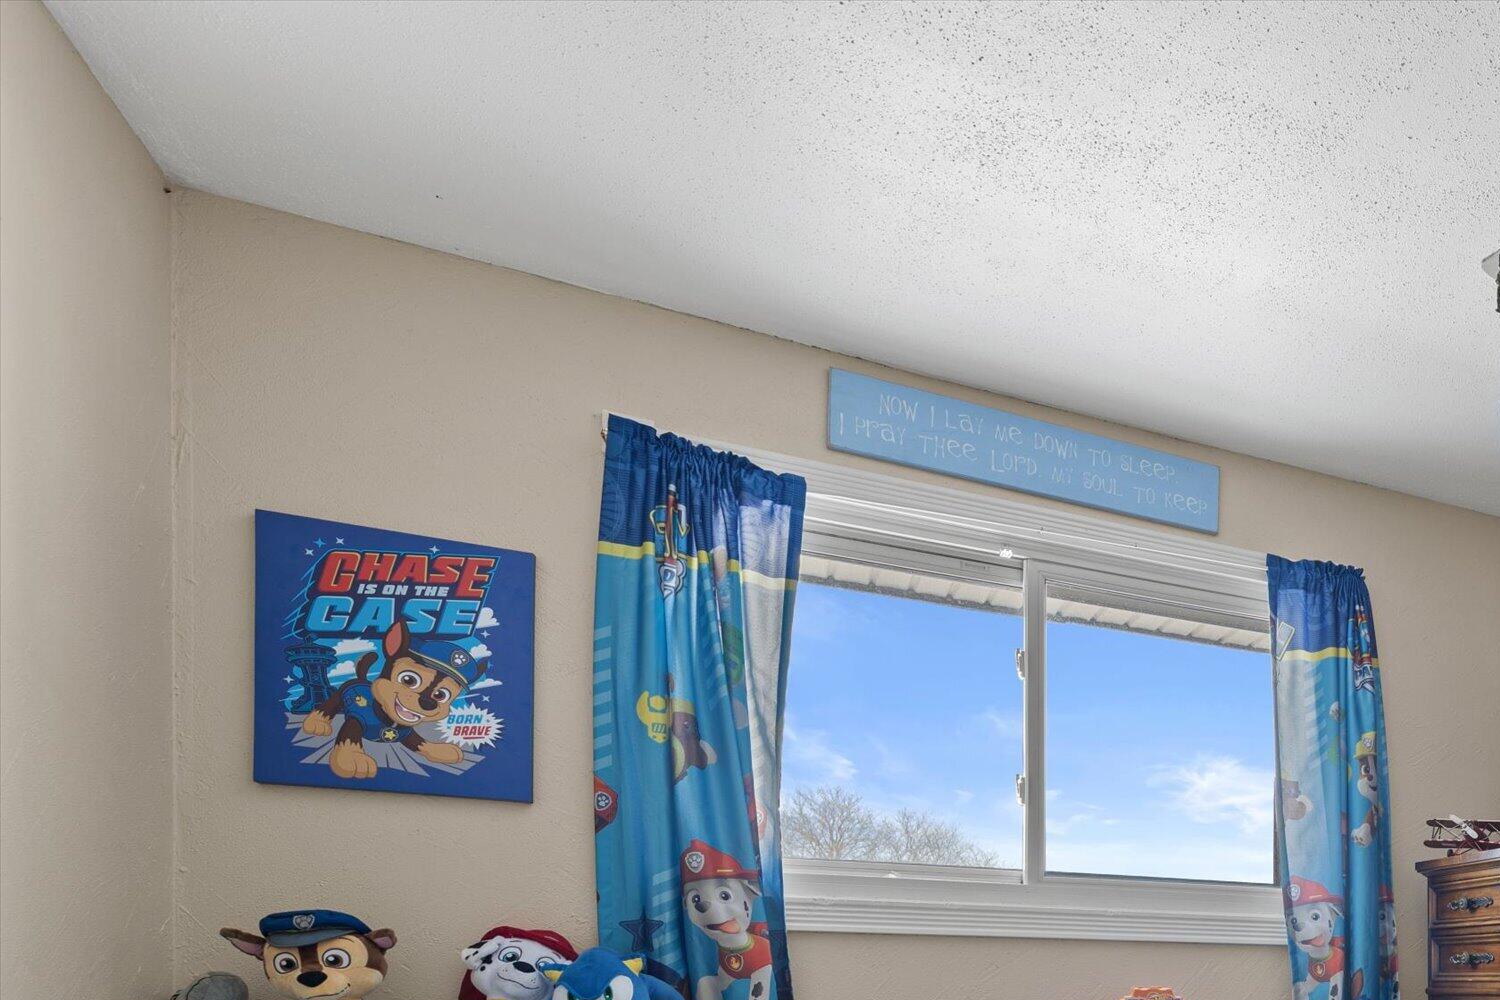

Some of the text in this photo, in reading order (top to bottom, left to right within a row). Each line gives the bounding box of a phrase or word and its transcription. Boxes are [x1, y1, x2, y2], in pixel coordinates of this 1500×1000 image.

[879, 393, 918, 423] NOW
[929, 405, 935, 428] I
[1034, 432, 1079, 461] DOWN
[1088, 448, 1112, 468] TO
[839, 412, 844, 438] I
[1083, 471, 1124, 498] SOUL
[1133, 486, 1156, 504] TO
[318, 551, 495, 598] CHASE
[357, 583, 450, 597] IS ON THE
[305, 595, 482, 636] CASE
[446, 714, 483, 725] BORN
[453, 726, 491, 736] BRAVE
